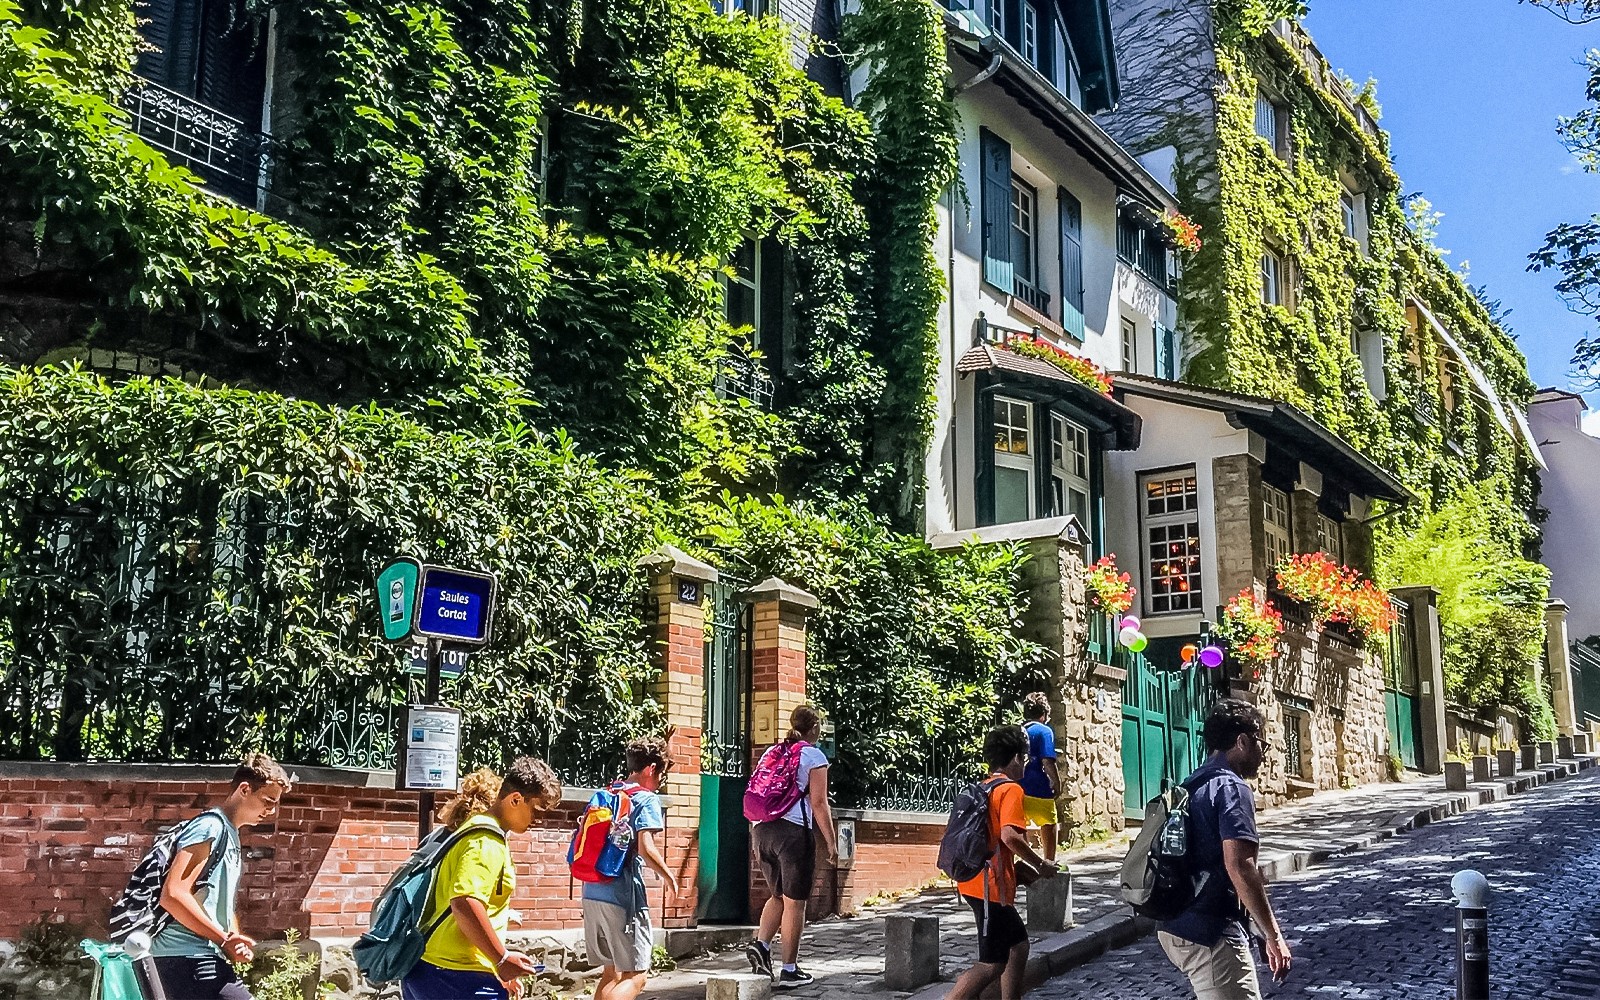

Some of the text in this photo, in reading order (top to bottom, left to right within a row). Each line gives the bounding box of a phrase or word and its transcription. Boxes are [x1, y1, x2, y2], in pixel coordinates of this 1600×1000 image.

[440, 590, 469, 604] Saules
[682, 584, 696, 600] 22
[438, 607, 467, 620] Cortot
[412, 646, 465, 666] COTOT
